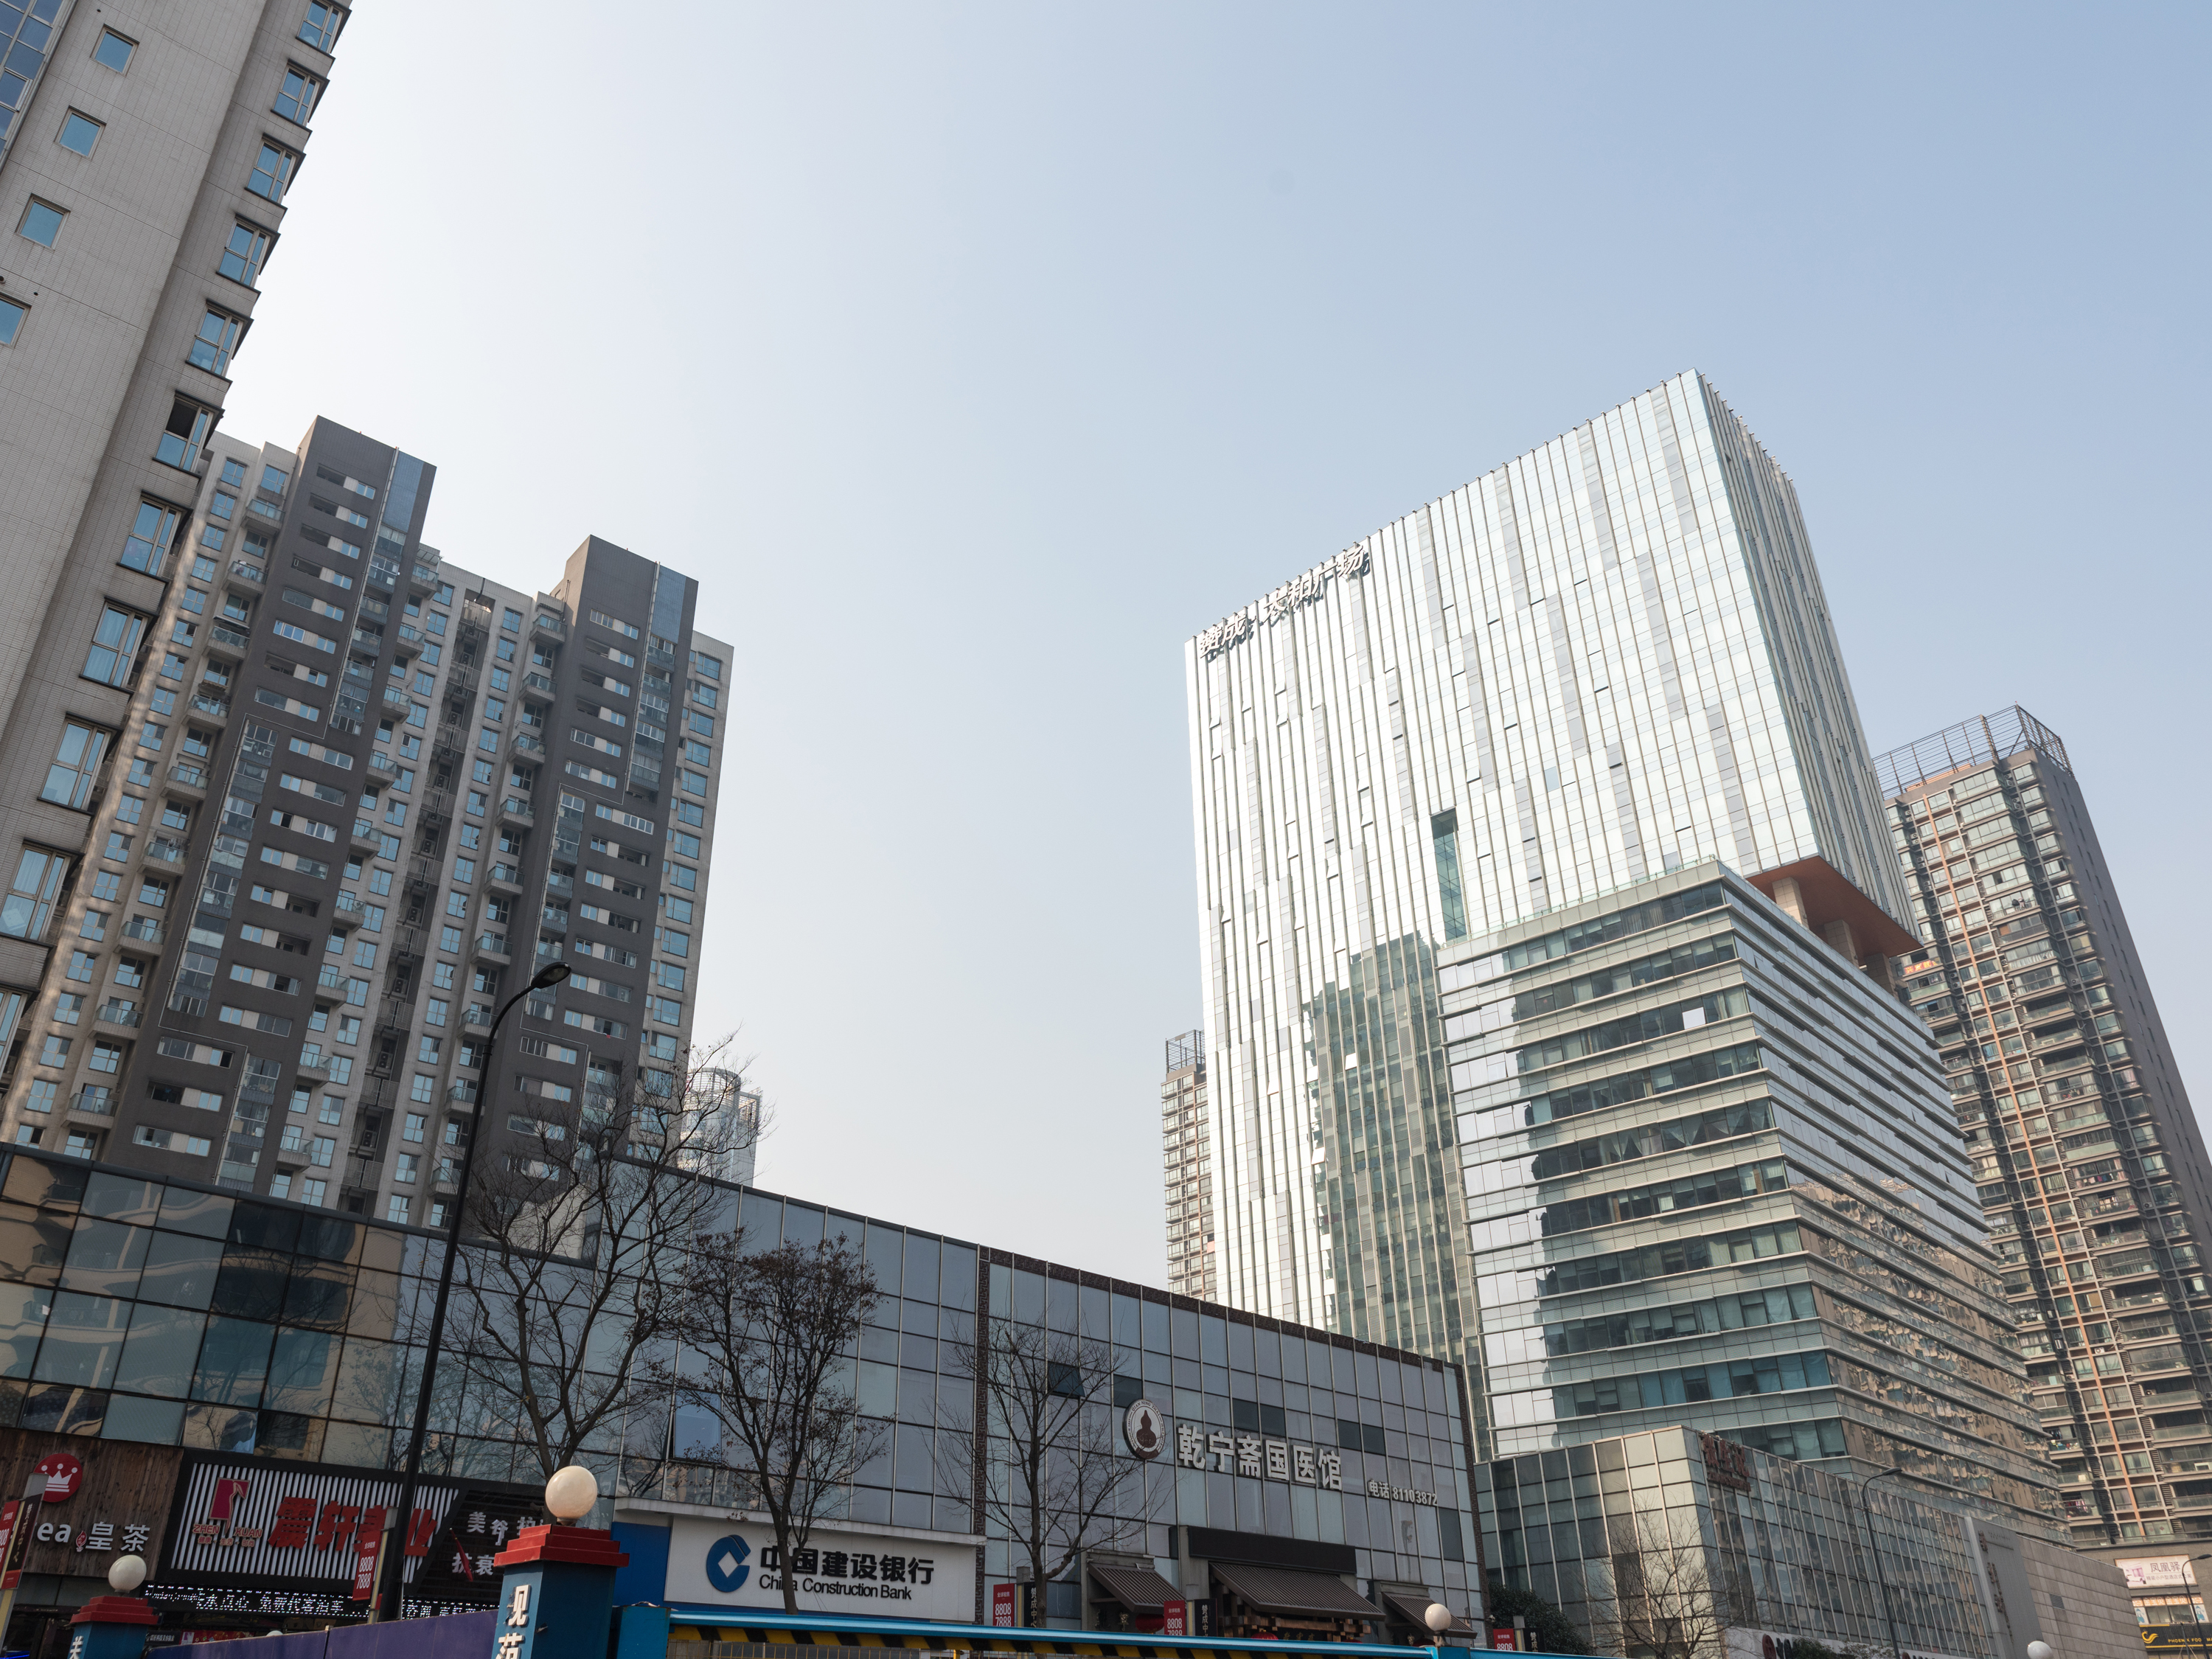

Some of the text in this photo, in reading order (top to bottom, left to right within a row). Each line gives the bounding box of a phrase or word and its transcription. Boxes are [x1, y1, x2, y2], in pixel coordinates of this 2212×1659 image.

[1178, 1423, 1343, 1491] 乾宁斋国医馆
[1368, 1479, 1438, 1506] 电话 81103872
[86, 1522, 150, 1552] 皇茶
[192, 1523, 263, 1538] ZHEN XUAN
[359, 1556, 375, 1573] 8808
[759, 1545, 934, 1585] 中国建设银行
[2150, 1561, 2181, 1573] 凤凰驿
[356, 1572, 372, 1590] 7888
[759, 1574, 912, 1600] Chia Construction Bank
[2143, 1596, 2165, 1606] 金宝贝
[2165, 1595, 2188, 1605] 金宝贝
[995, 1602, 1012, 1616] 8808
[995, 1615, 1012, 1627] 7888
[1166, 1618, 1183, 1630] 8808
[1497, 1643, 1513, 1651] 8808
